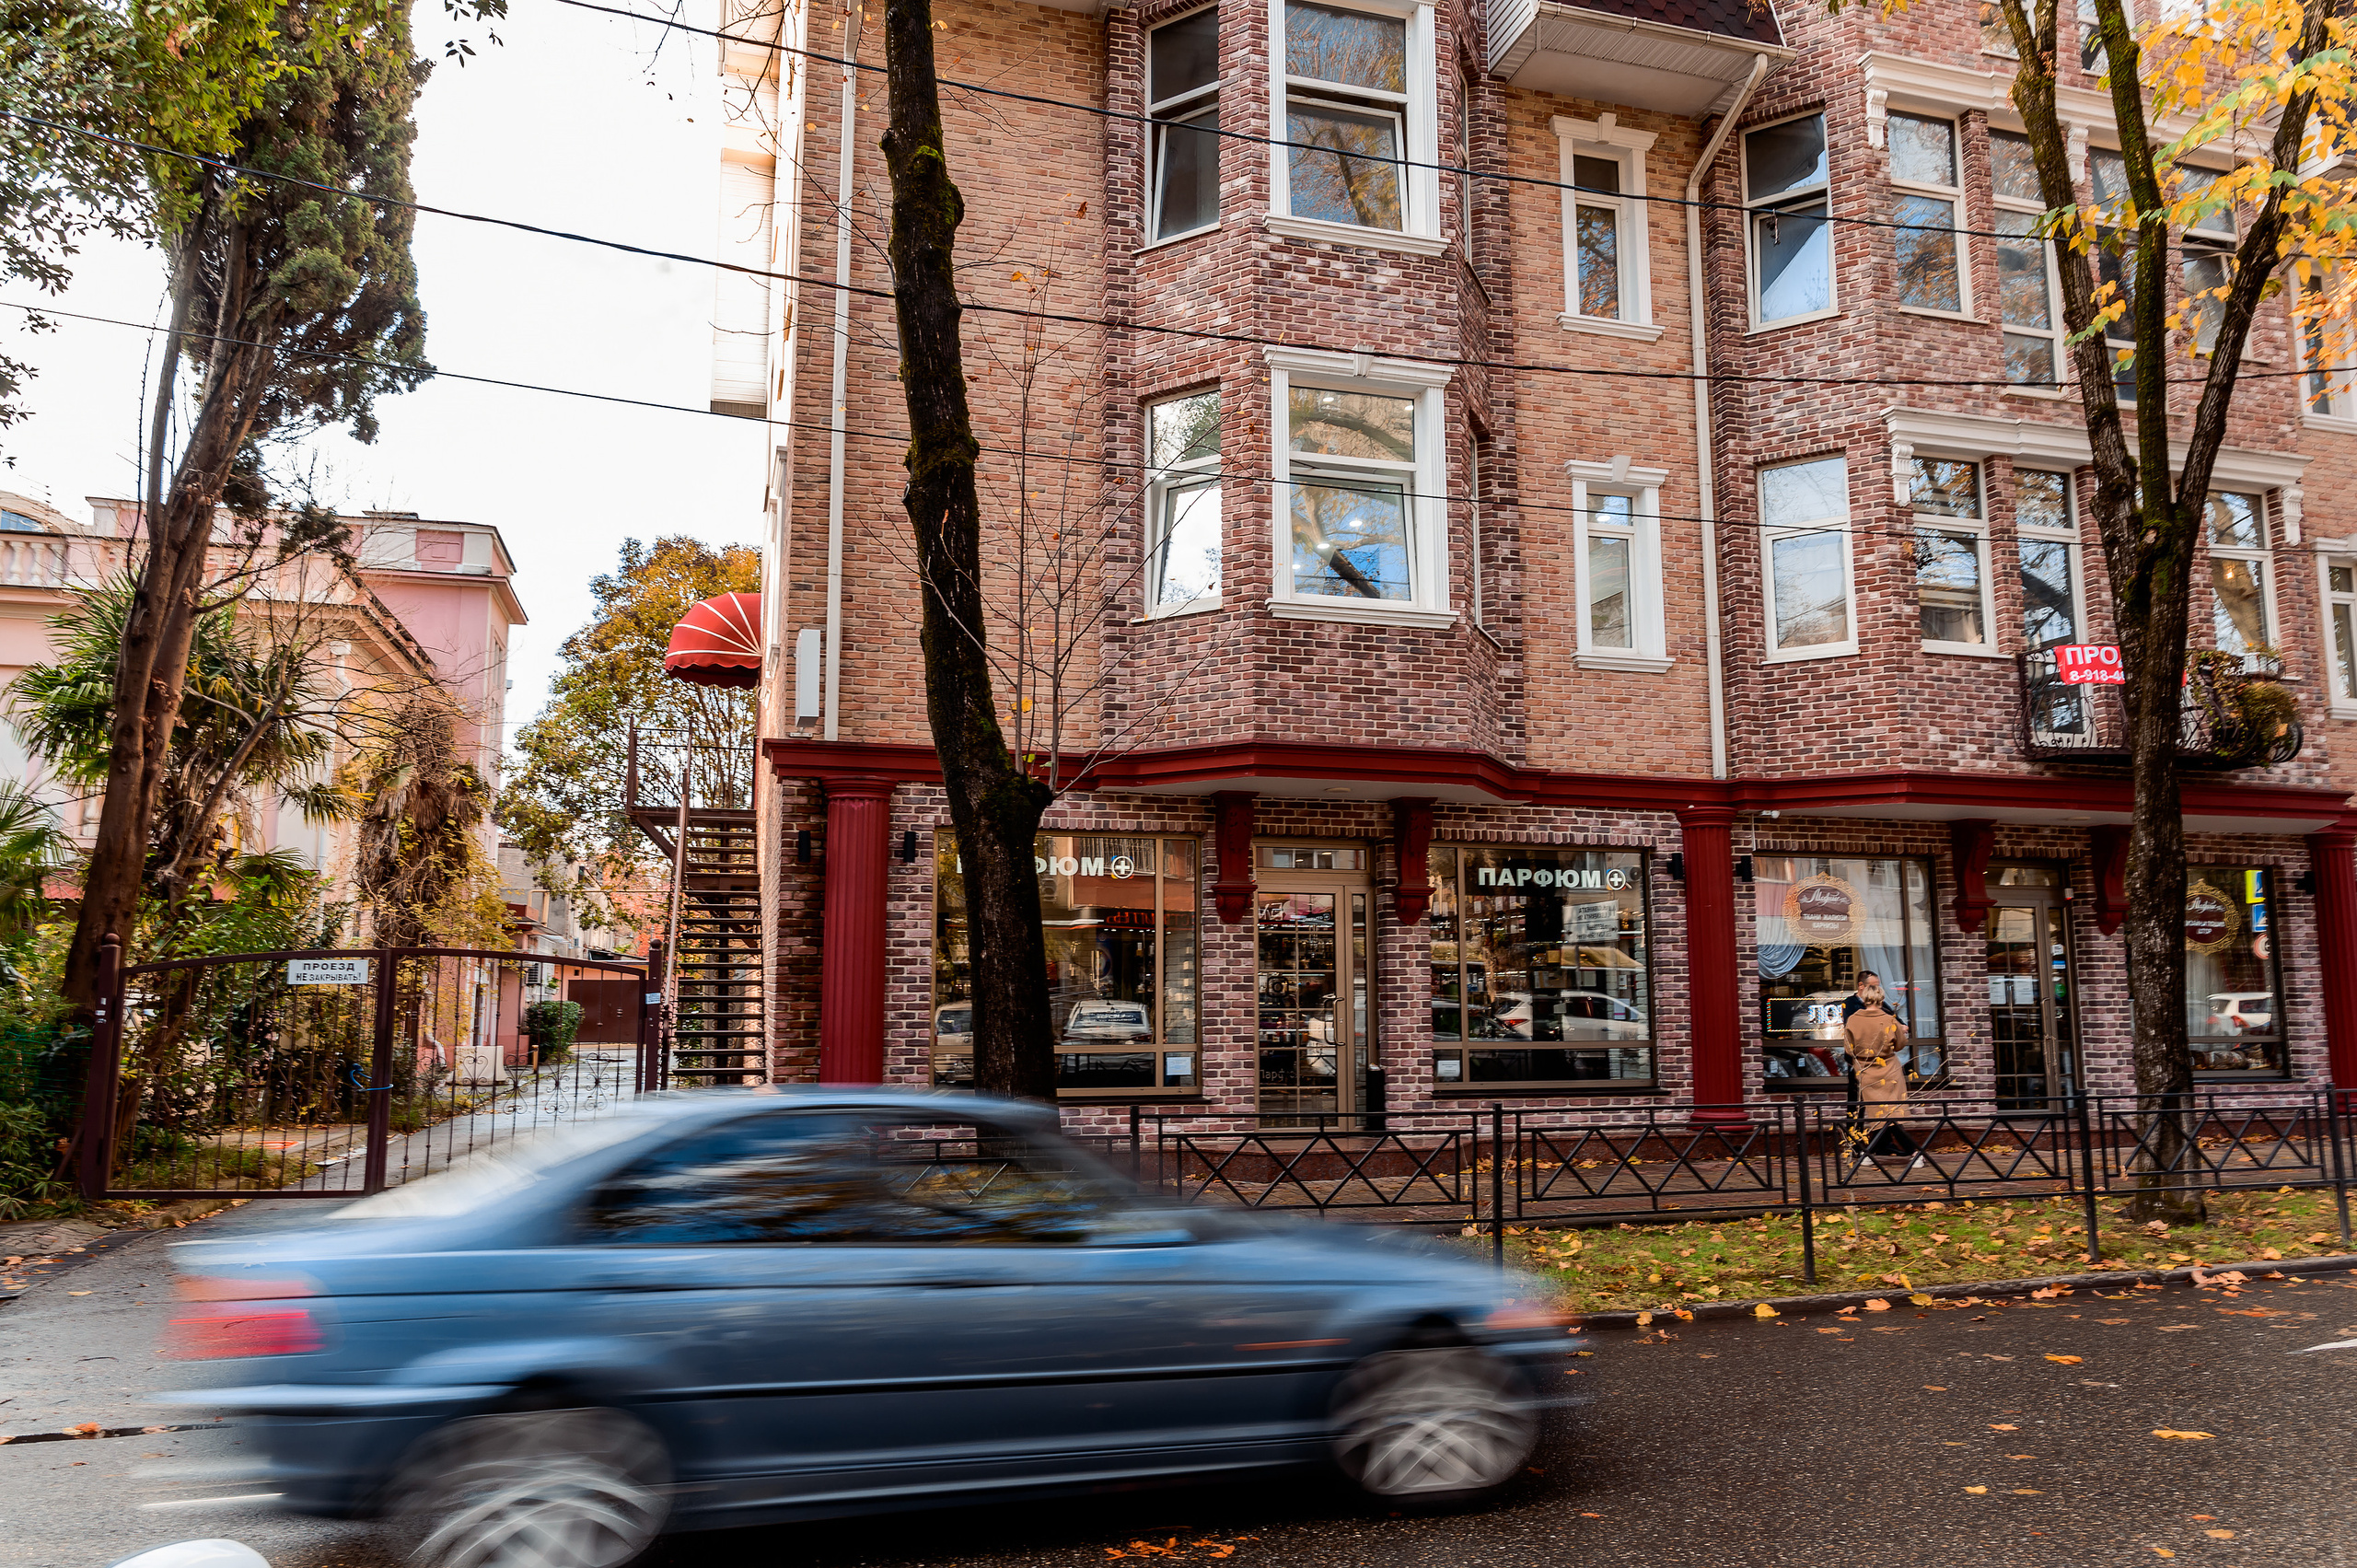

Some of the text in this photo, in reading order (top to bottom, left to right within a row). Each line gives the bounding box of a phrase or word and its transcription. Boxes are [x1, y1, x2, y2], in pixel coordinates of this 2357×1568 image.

[2065, 646, 2122, 668] ПРО
[1478, 867, 1601, 888] ПАРФЮМ
[303, 963, 355, 971] ПРОЕЗД
[296, 972, 362, 981] НЕ ЗАКРЫВАТЬ!
